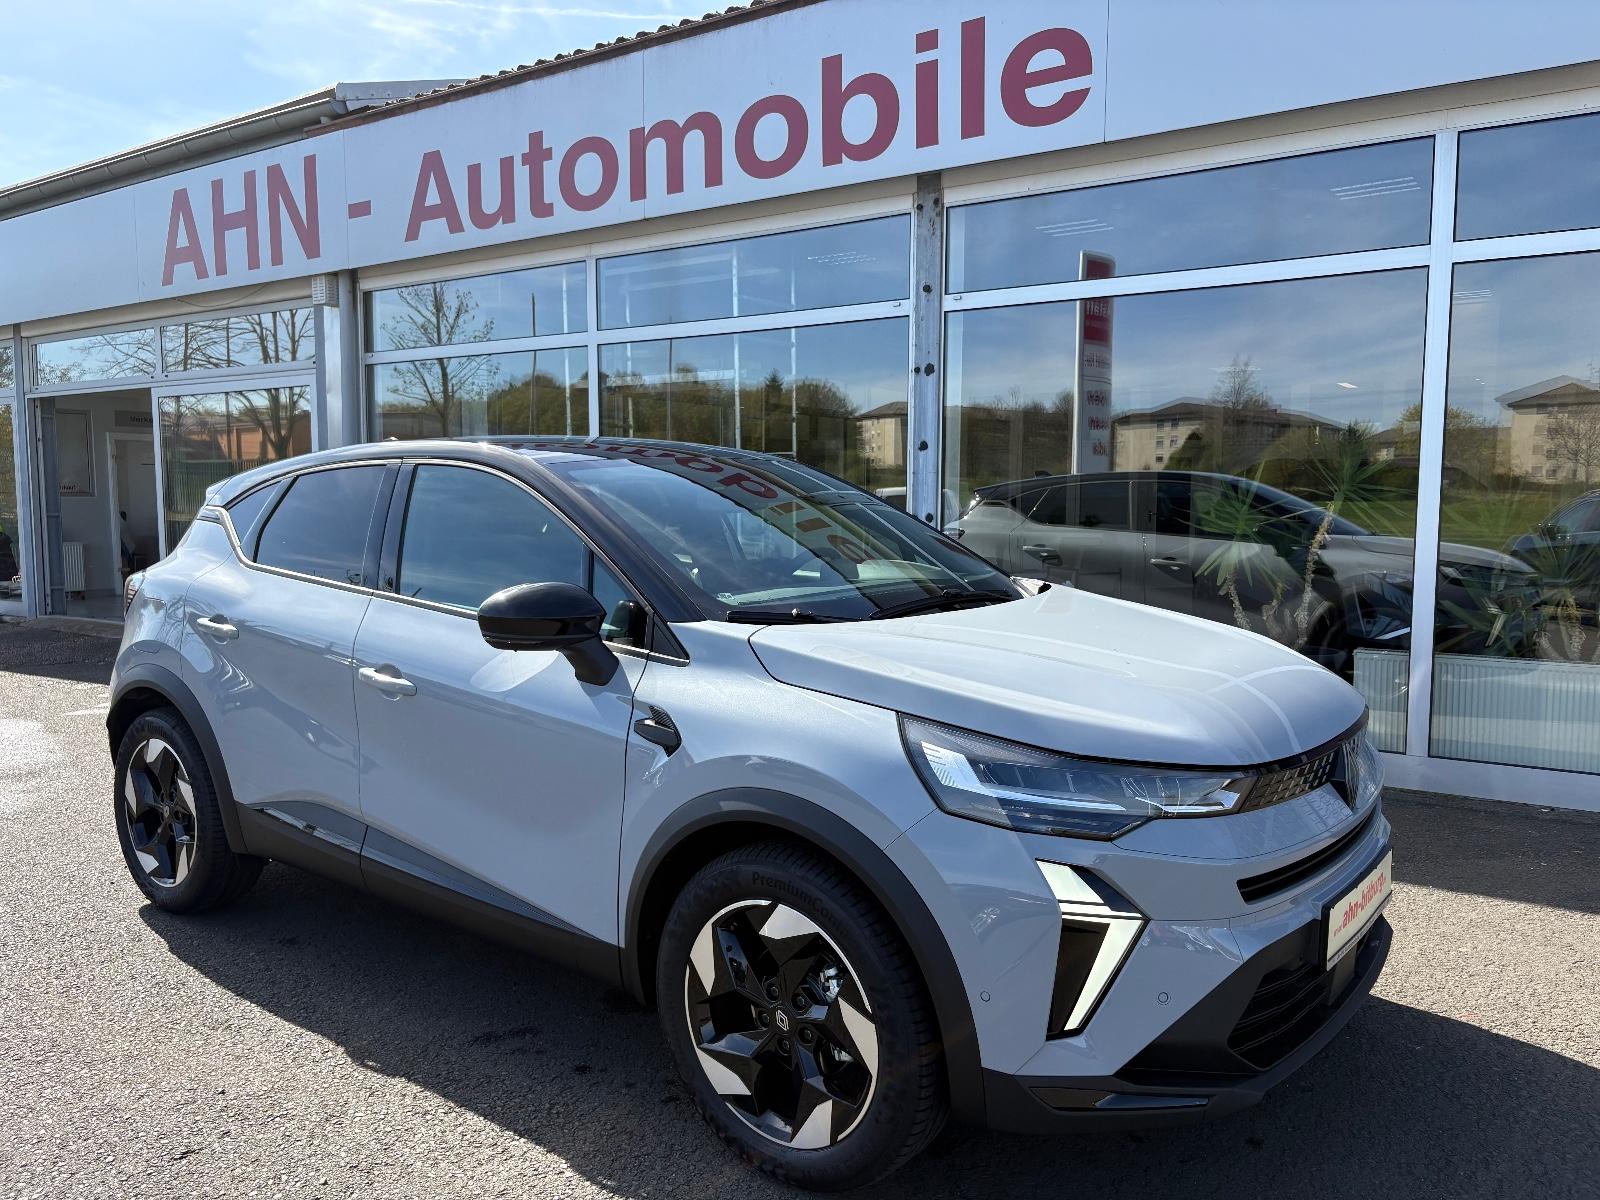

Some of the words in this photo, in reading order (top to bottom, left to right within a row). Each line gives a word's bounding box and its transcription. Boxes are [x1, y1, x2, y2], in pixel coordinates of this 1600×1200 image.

[162, 154, 321, 287] AHN
[348, 200, 371, 219] -
[404, 16, 1093, 242] Automobile
